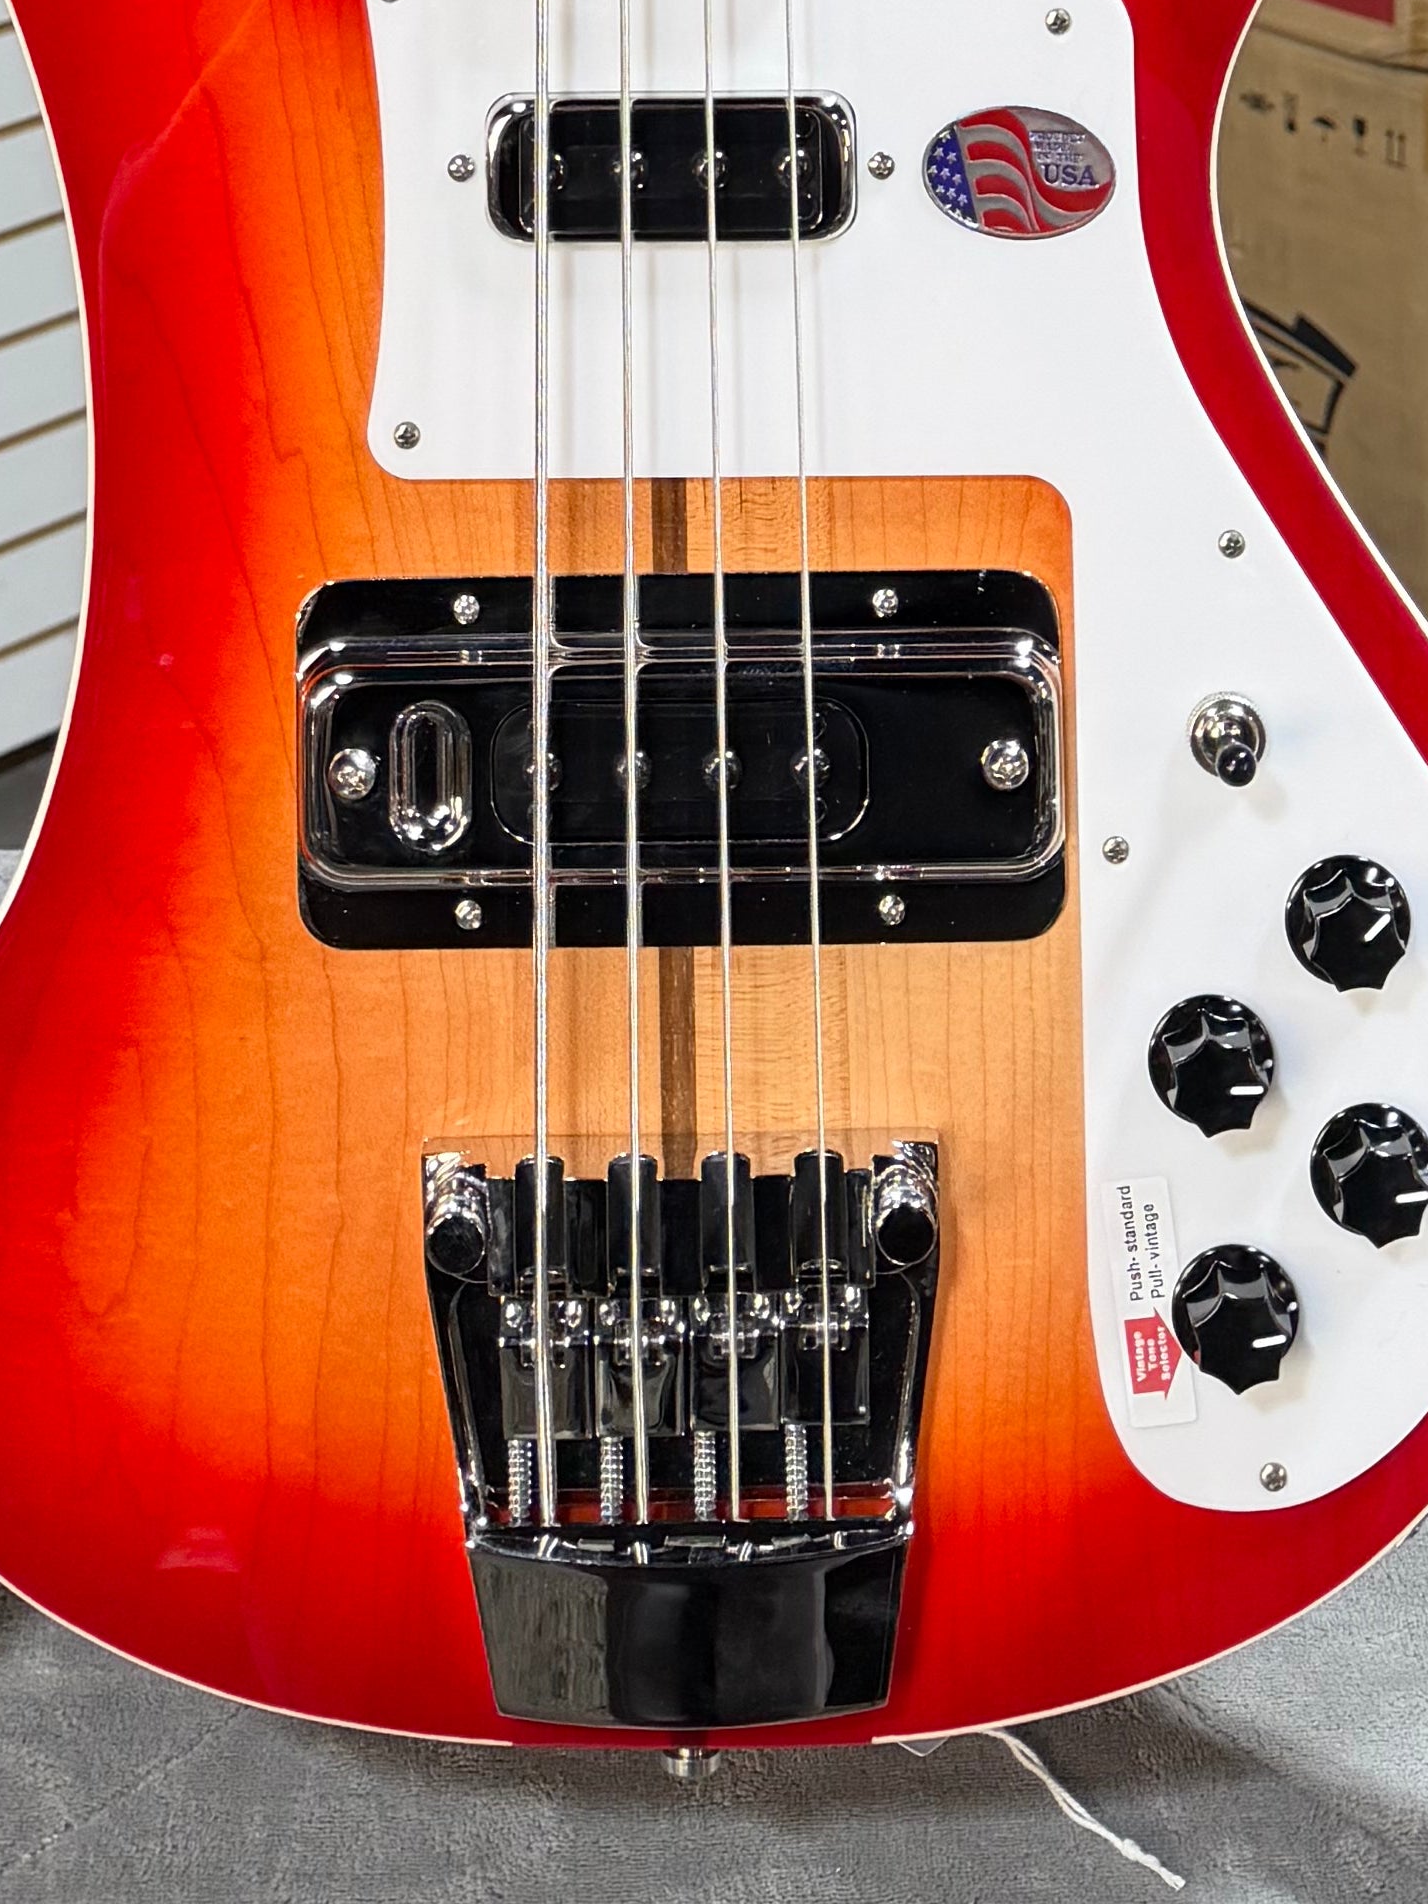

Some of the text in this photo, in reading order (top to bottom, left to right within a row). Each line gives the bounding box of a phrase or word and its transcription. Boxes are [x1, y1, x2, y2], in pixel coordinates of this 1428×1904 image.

[1041, 163, 1100, 187] USA
[1116, 1185, 1139, 1254] standard
[1143, 1203, 1160, 1261] vintage
[1132, 1331, 1149, 1383] Vintage
[1147, 1338, 1158, 1372] Tone
[1156, 1325, 1172, 1381] Selector
